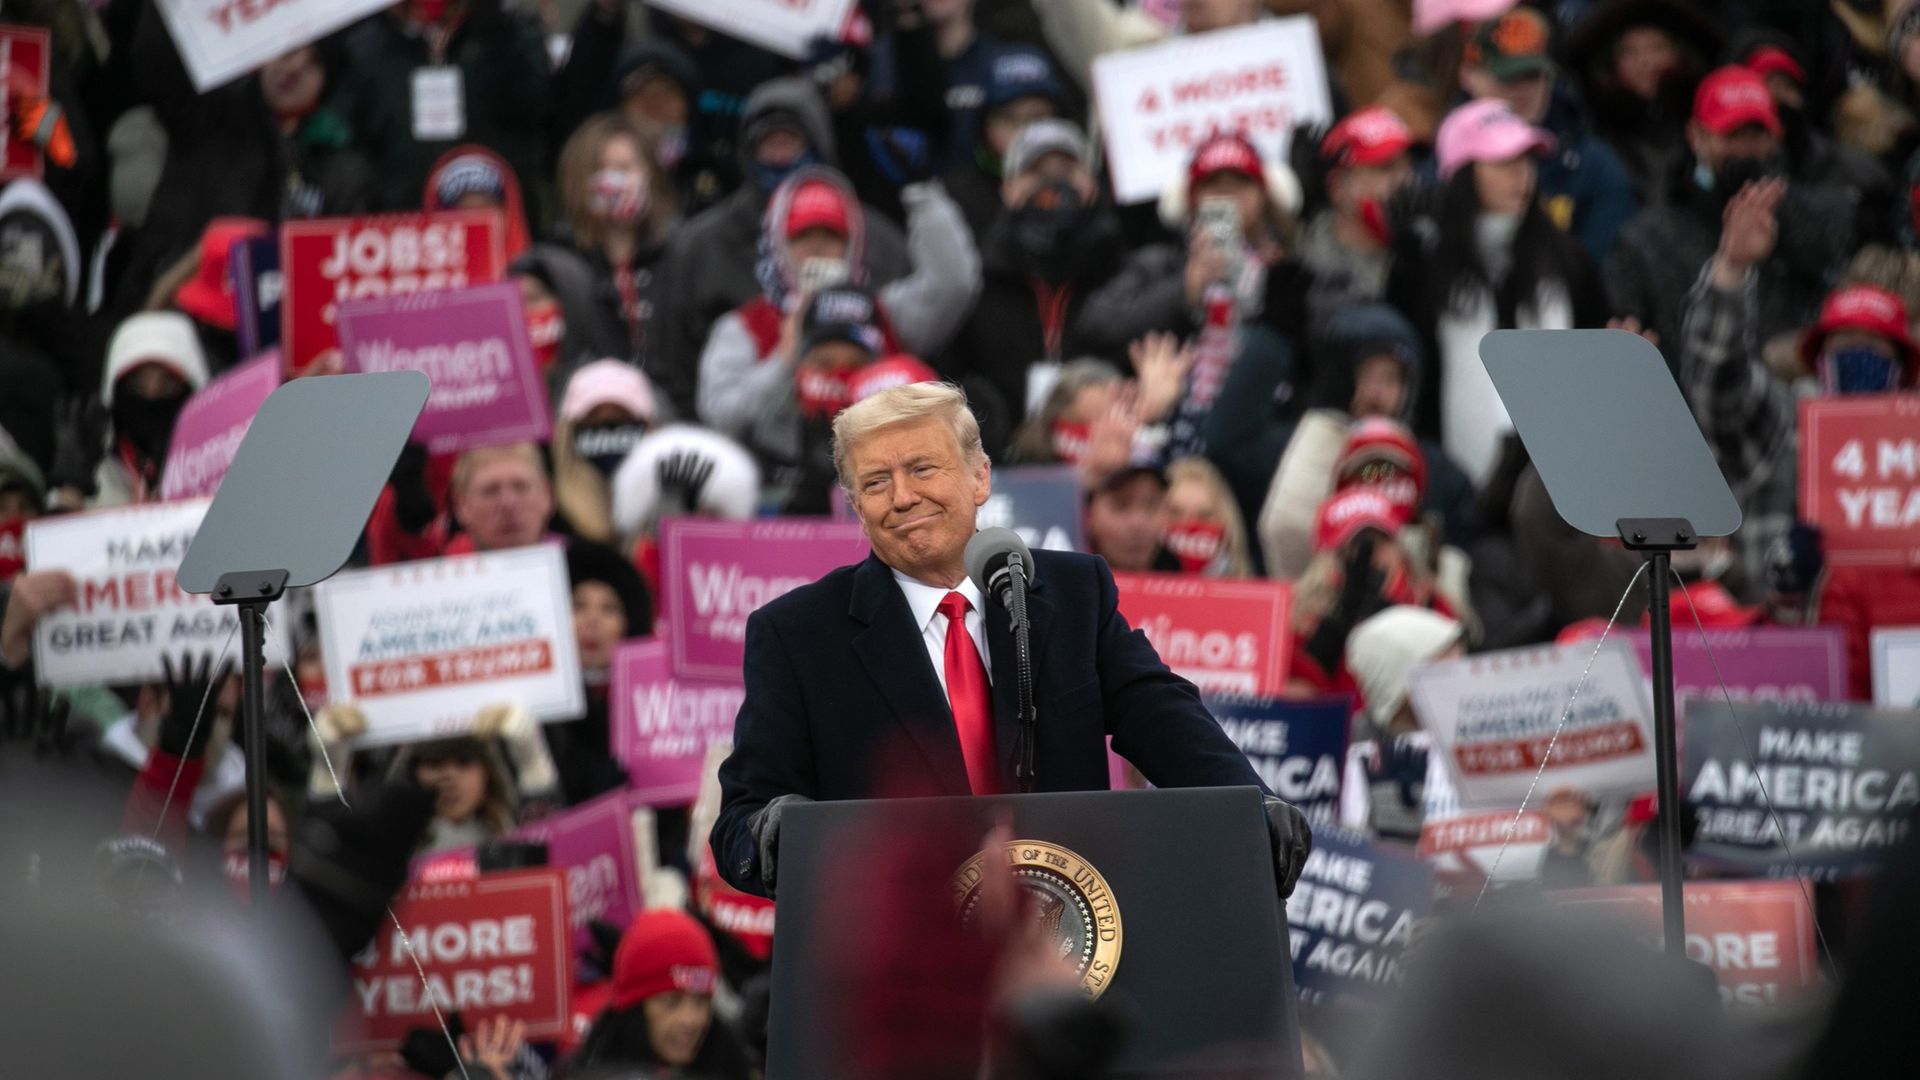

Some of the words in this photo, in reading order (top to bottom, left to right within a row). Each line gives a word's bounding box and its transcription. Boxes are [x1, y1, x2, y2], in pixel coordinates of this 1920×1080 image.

[1172, 60, 1287, 106] MORE
[321, 221, 468, 280] JOBS!
[1832, 435, 1867, 481] 4
[1874, 435, 1920, 481] M
[106, 532, 193, 566] MAK
[51, 614, 157, 653] GREAT
[357, 656, 428, 693] FOR
[438, 640, 549, 681] TRUMP
[632, 678, 746, 736] Wom
[1212, 716, 1289, 756] AKE
[1758, 726, 1865, 767] MAKE
[1686, 757, 1920, 812] AMERICA
[1301, 847, 1374, 894] AKE
[1022, 849, 1041, 861] OF
[1045, 851, 1070, 871] THE
[1073, 865, 1117, 943] UNITED
[1285, 881, 1414, 948] ERICA
[390, 914, 538, 966] MORE
[1685, 930, 1780, 968] ORE
[353, 962, 536, 1016] YEARS!
